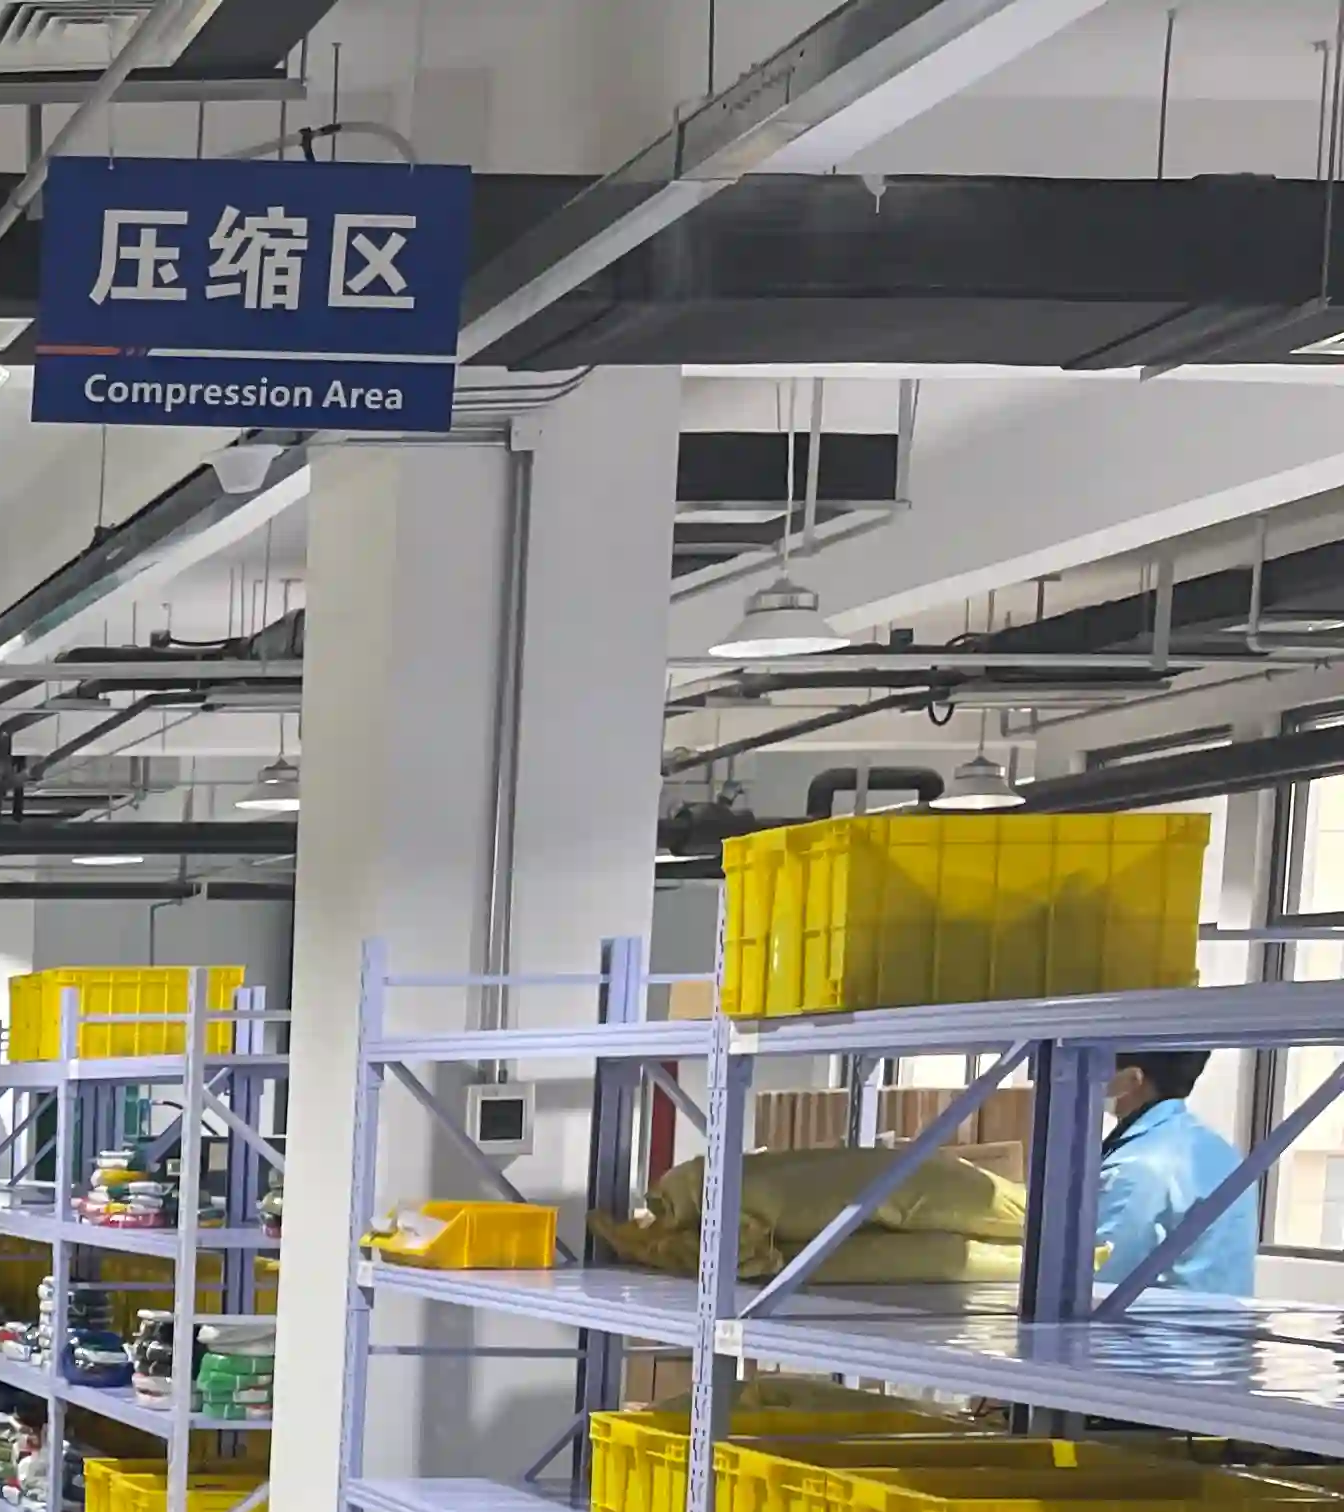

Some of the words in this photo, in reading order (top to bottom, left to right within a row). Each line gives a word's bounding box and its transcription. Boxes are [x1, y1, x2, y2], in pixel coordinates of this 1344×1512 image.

[89, 205, 417, 310] 压缩区
[84, 374, 312, 412] Compression
[322, 380, 404, 410] Area
